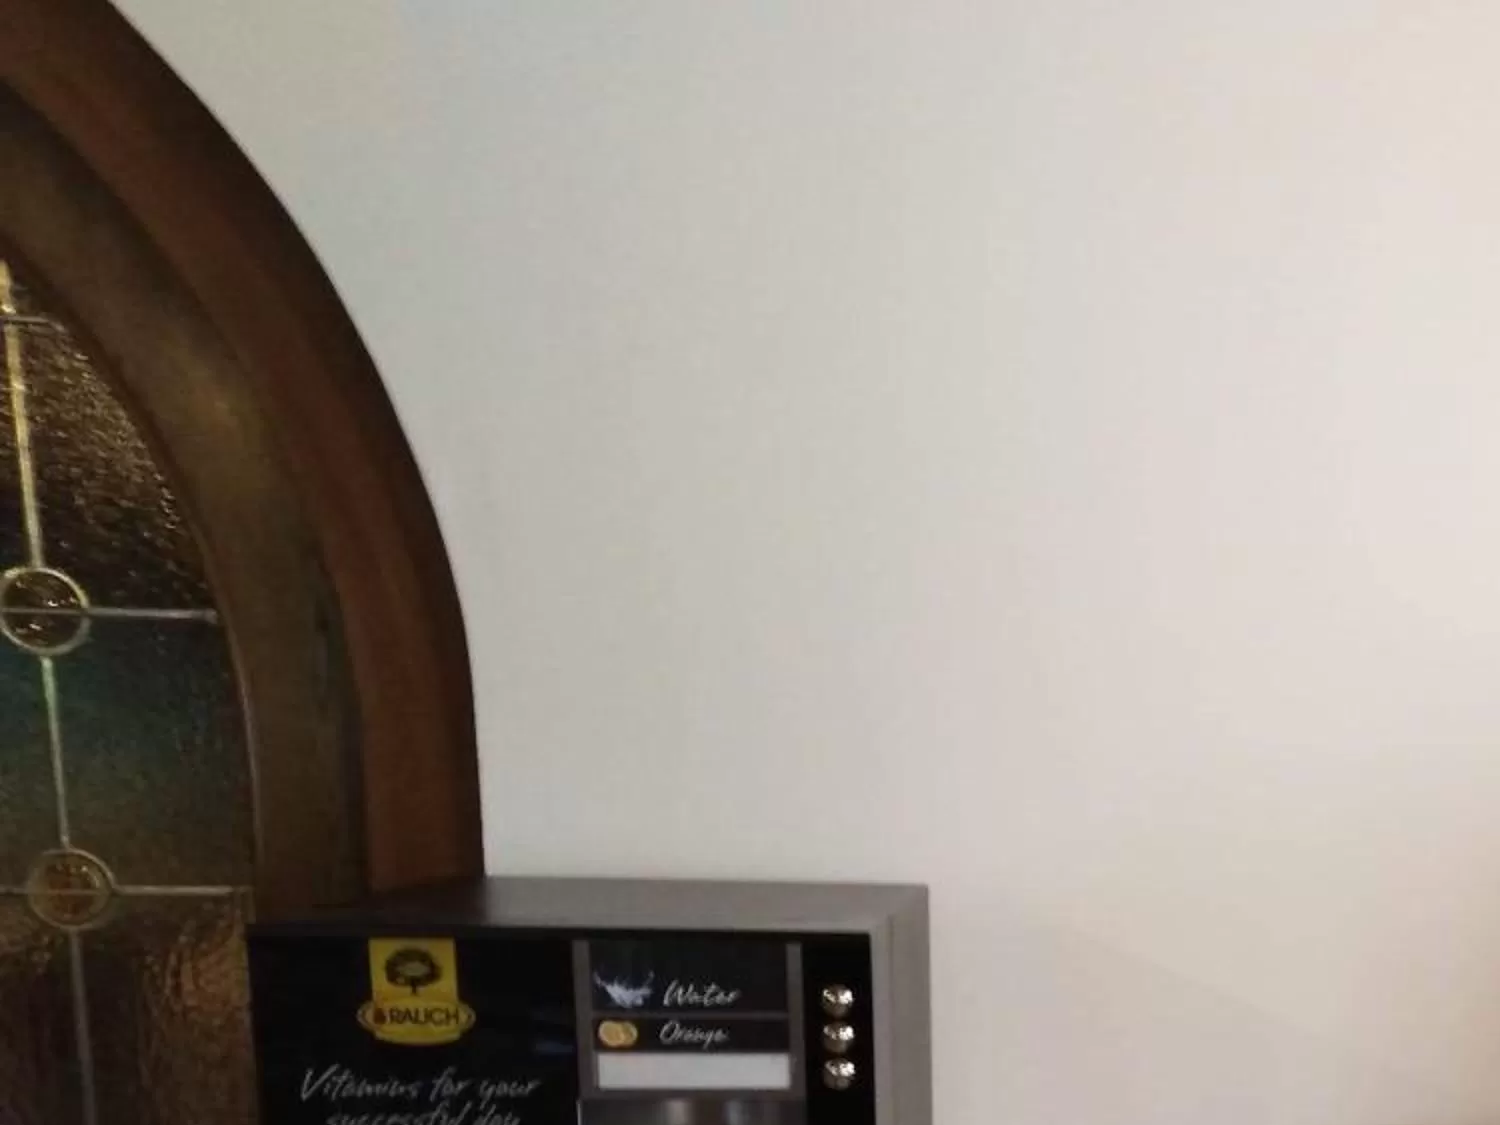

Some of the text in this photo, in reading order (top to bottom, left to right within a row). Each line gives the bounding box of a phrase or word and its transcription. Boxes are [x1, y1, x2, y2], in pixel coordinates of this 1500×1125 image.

[662, 980, 740, 1007] Water
[389, 1007, 460, 1026] RAUCH
[659, 1019, 728, 1049] Orange
[300, 1063, 541, 1110] Vitamins for your
